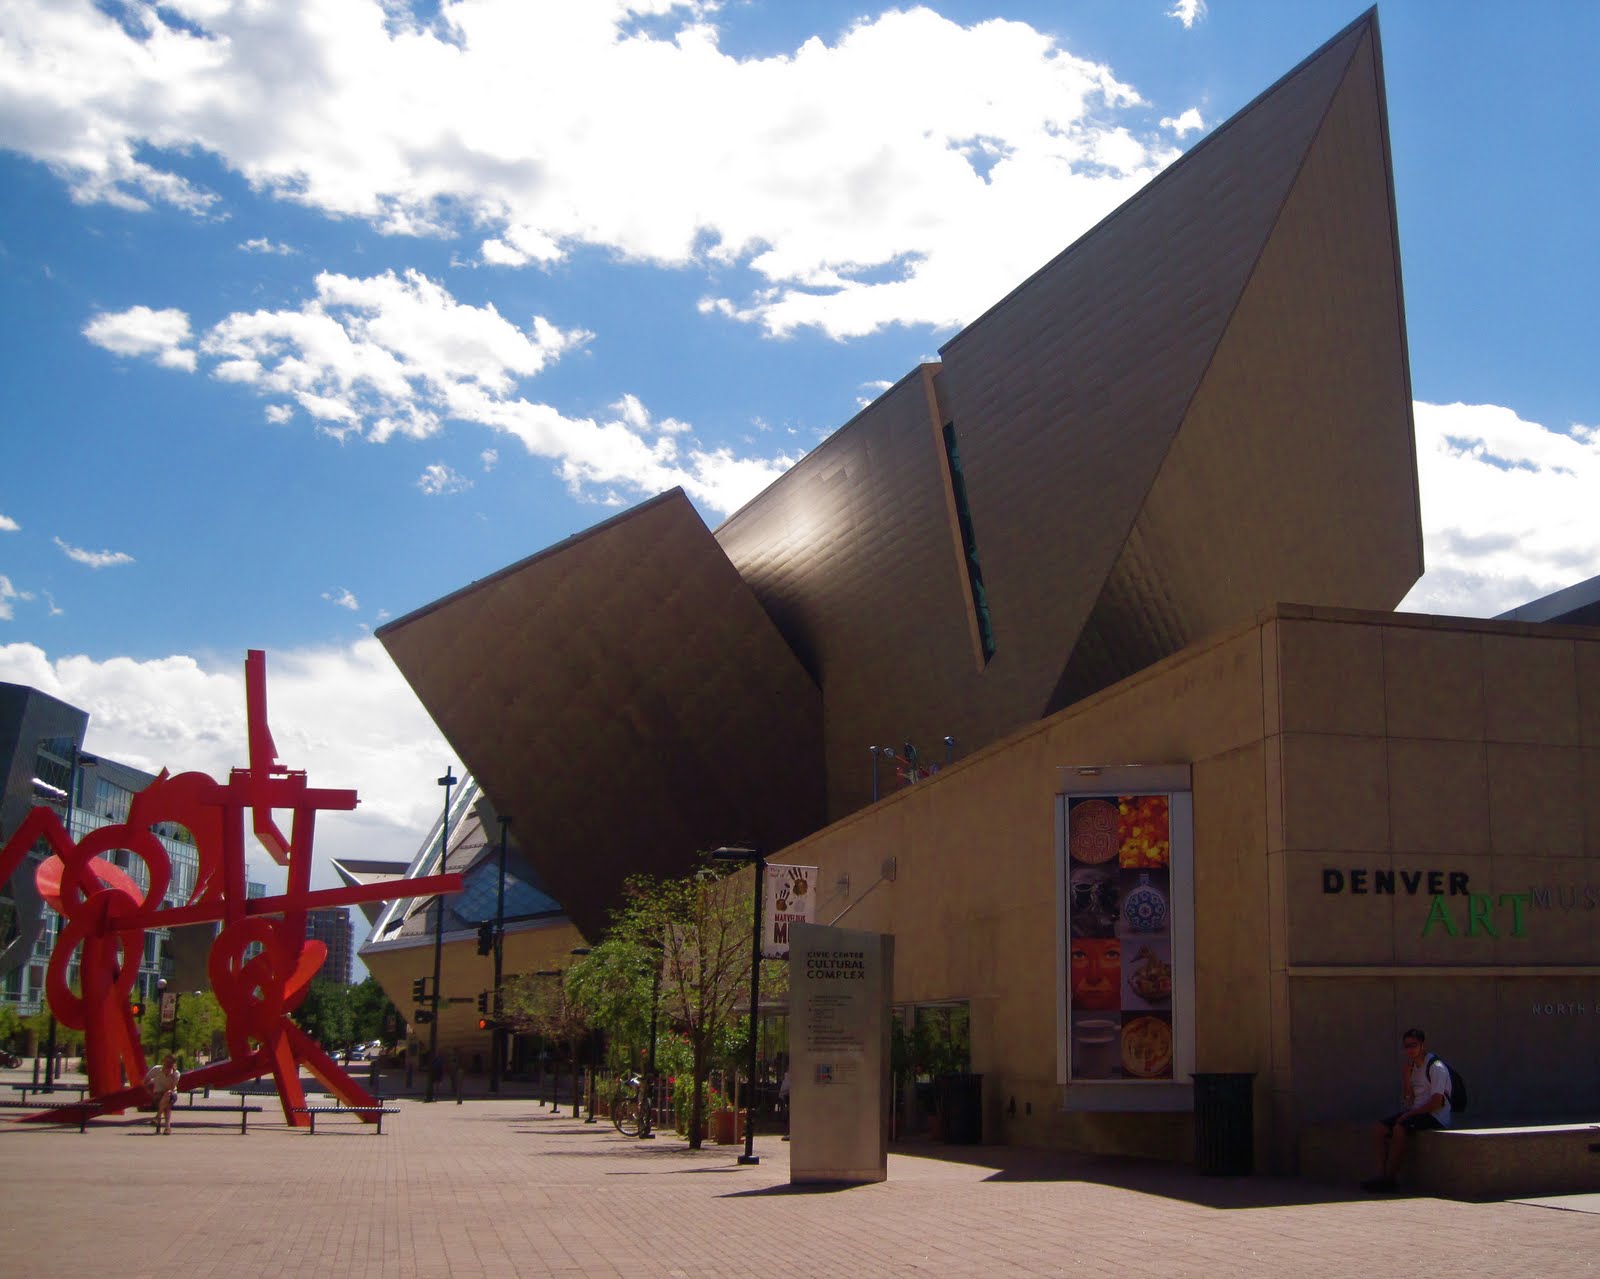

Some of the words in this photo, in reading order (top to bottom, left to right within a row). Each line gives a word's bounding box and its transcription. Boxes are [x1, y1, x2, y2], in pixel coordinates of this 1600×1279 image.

[1322, 868, 1470, 896] DENVER
[1421, 893, 1530, 938] ART
[773, 922, 790, 944] M
[833, 951, 864, 959] CENTER
[807, 959, 865, 969] CULTURAL
[807, 970, 865, 980] COMPLEX
[1532, 1002, 1586, 1016] NORTH
